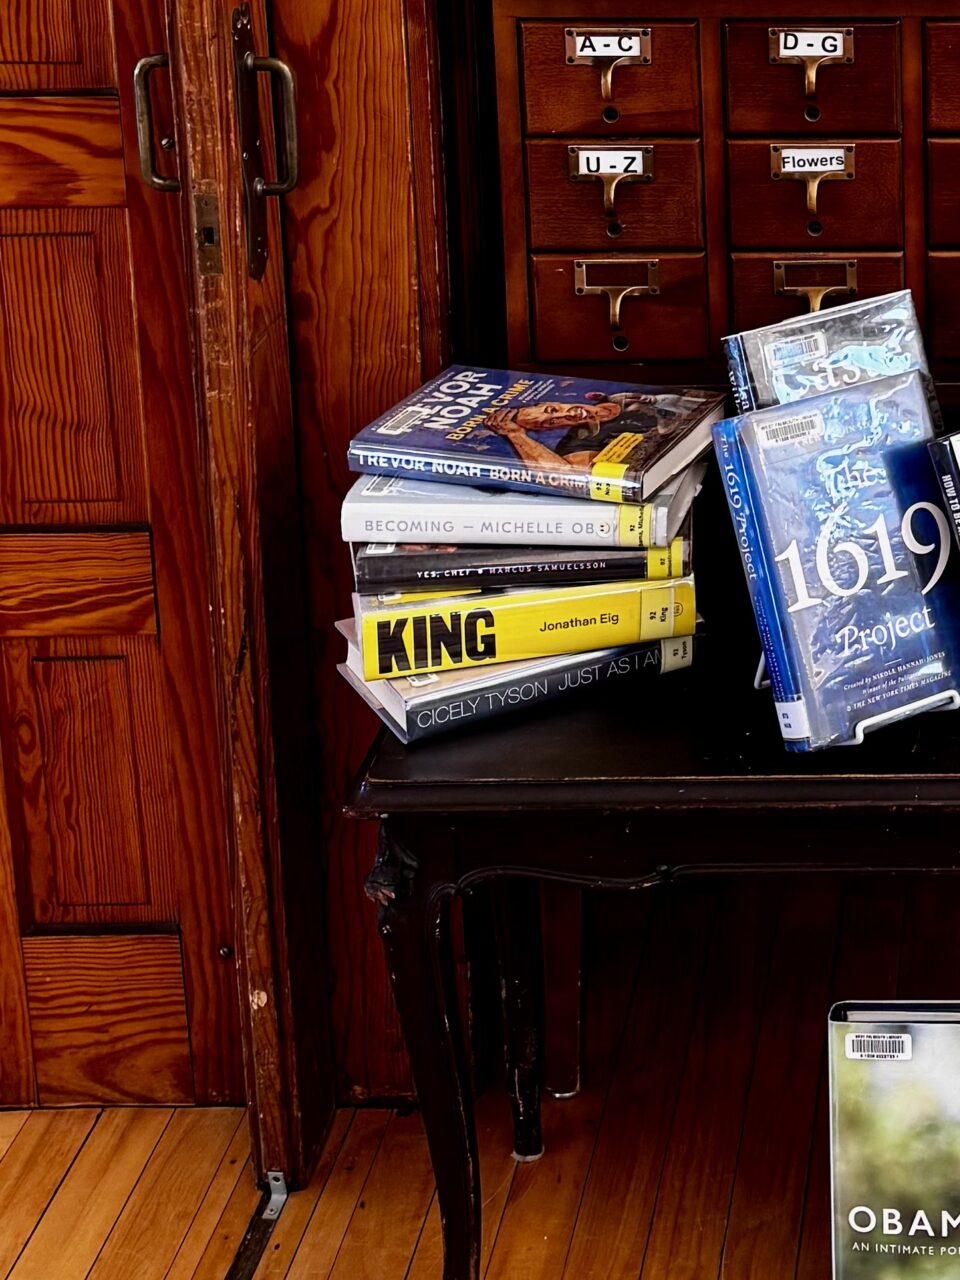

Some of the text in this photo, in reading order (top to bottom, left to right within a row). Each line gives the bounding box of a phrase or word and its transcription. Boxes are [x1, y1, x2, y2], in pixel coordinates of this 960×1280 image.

[579, 36, 634, 53] A C
[783, 33, 839, 54] D G
[586, 156, 638, 174] U Z
[782, 154, 845, 169] Flowers
[424, 383, 503, 430] NOAH
[446, 414, 485, 441] BORN
[491, 379, 535, 408] CRIME
[358, 452, 547, 485] TREVOR NOAH BORN A
[941, 473, 953, 501] HOW
[949, 501, 960, 517] TO
[365, 520, 455, 533] BECOMING
[480, 521, 564, 534] MICHELLE
[724, 462, 757, 581] 1619 Project
[774, 501, 951, 613] 1619
[490, 561, 607, 575] MARCUS SAMUELSSON
[540, 612, 619, 633] Jonathan Eig
[649, 611, 657, 621] 92
[660, 607, 669, 623] King
[376, 606, 497, 675] KING
[835, 606, 936, 656] Project
[417, 696, 480, 729] CICELY
[485, 679, 548, 710] TYSON
[558, 667, 600, 692] JUST
[606, 658, 631, 678] AS
[634, 655, 640, 671] I
[852, 1242, 870, 1252] AN
[875, 1243, 935, 1256] INTIMATE
